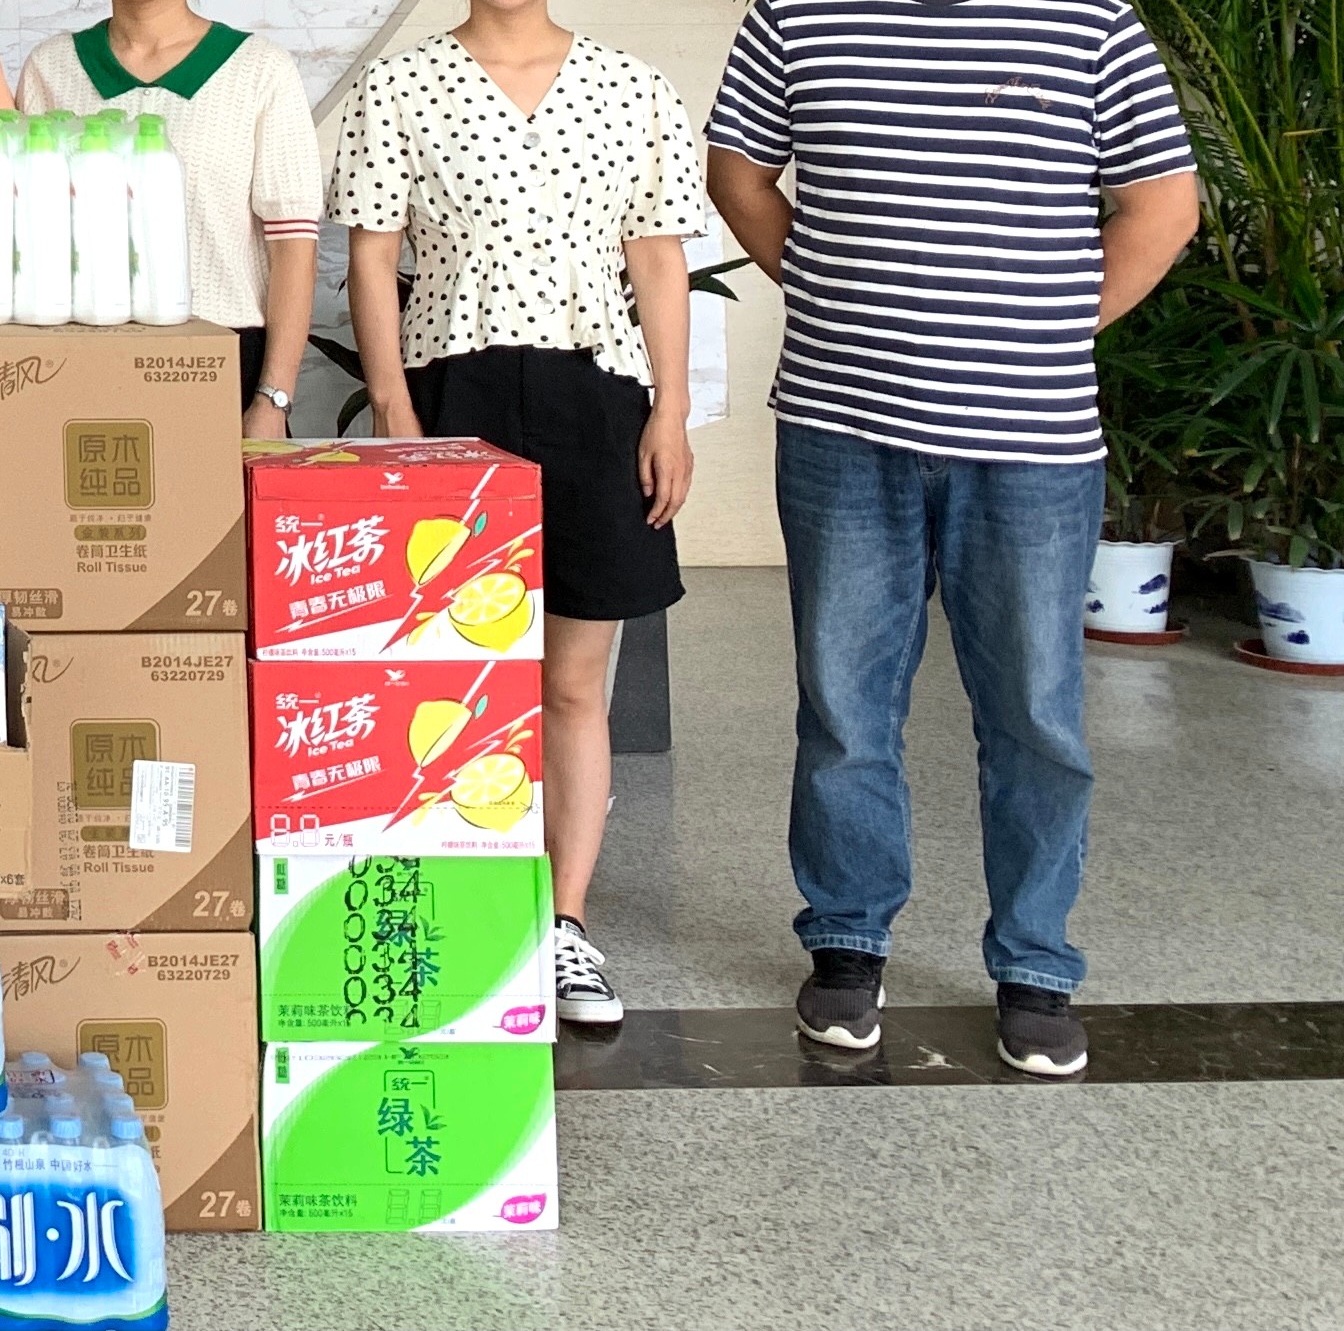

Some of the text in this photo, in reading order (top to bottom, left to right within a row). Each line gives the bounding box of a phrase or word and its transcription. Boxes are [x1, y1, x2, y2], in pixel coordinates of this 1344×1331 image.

[134, 355, 226, 370] B2014JE27
[143, 370, 218, 383] 63220729
[78, 434, 141, 463] 原木
[79, 467, 141, 497] 纯品
[274, 514, 323, 533] 统一
[76, 544, 148, 559] 卷筒卫生纸
[274, 514, 391, 587] 冰红茶
[76, 561, 148, 573] Roll Tissue
[310, 564, 361, 585] Ice Tea
[185, 589, 239, 617] 27卷
[288, 580, 387, 620] 青春无极限
[141, 655, 234, 668] B2014JE27
[150, 670, 225, 682] 63220729
[275, 692, 320, 710] 统一
[274, 692, 381, 758] 冰红茶
[85, 732, 147, 763] 原木
[307, 738, 355, 758] Ice Tea
[291, 755, 382, 791] 青春无极限
[83, 861, 155, 873] Roll Tissue
[193, 890, 247, 918] 27卷
[147, 954, 240, 968] B2014JE27
[2, 955, 81, 1001] 清风
[156, 969, 231, 981] 63220729
[392, 1077, 428, 1091] 统一
[377, 1096, 442, 1177] 绿茶
[199, 1190, 253, 1218] 27卷
[278, 1193, 358, 1207] 茉莉味茶饮料
